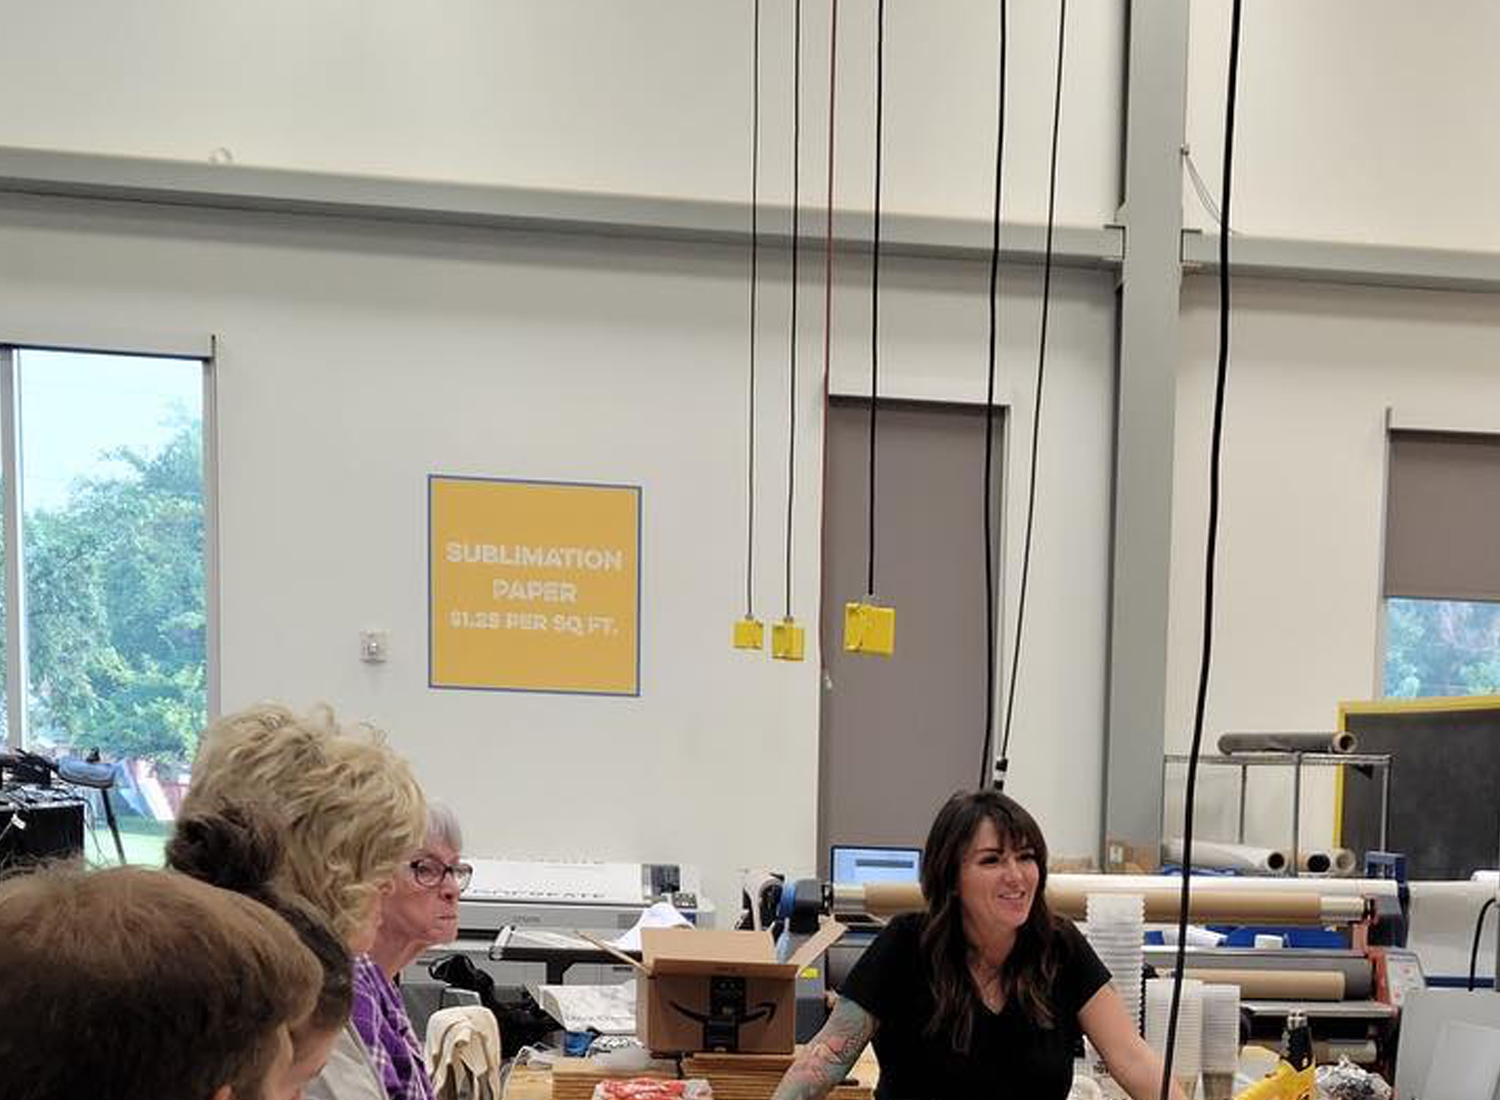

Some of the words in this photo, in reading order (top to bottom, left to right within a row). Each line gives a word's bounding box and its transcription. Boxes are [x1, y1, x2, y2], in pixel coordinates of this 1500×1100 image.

[445, 541, 624, 571] SUBLIMATION
[492, 578, 578, 603] PAPER
[506, 612, 548, 631] PER
